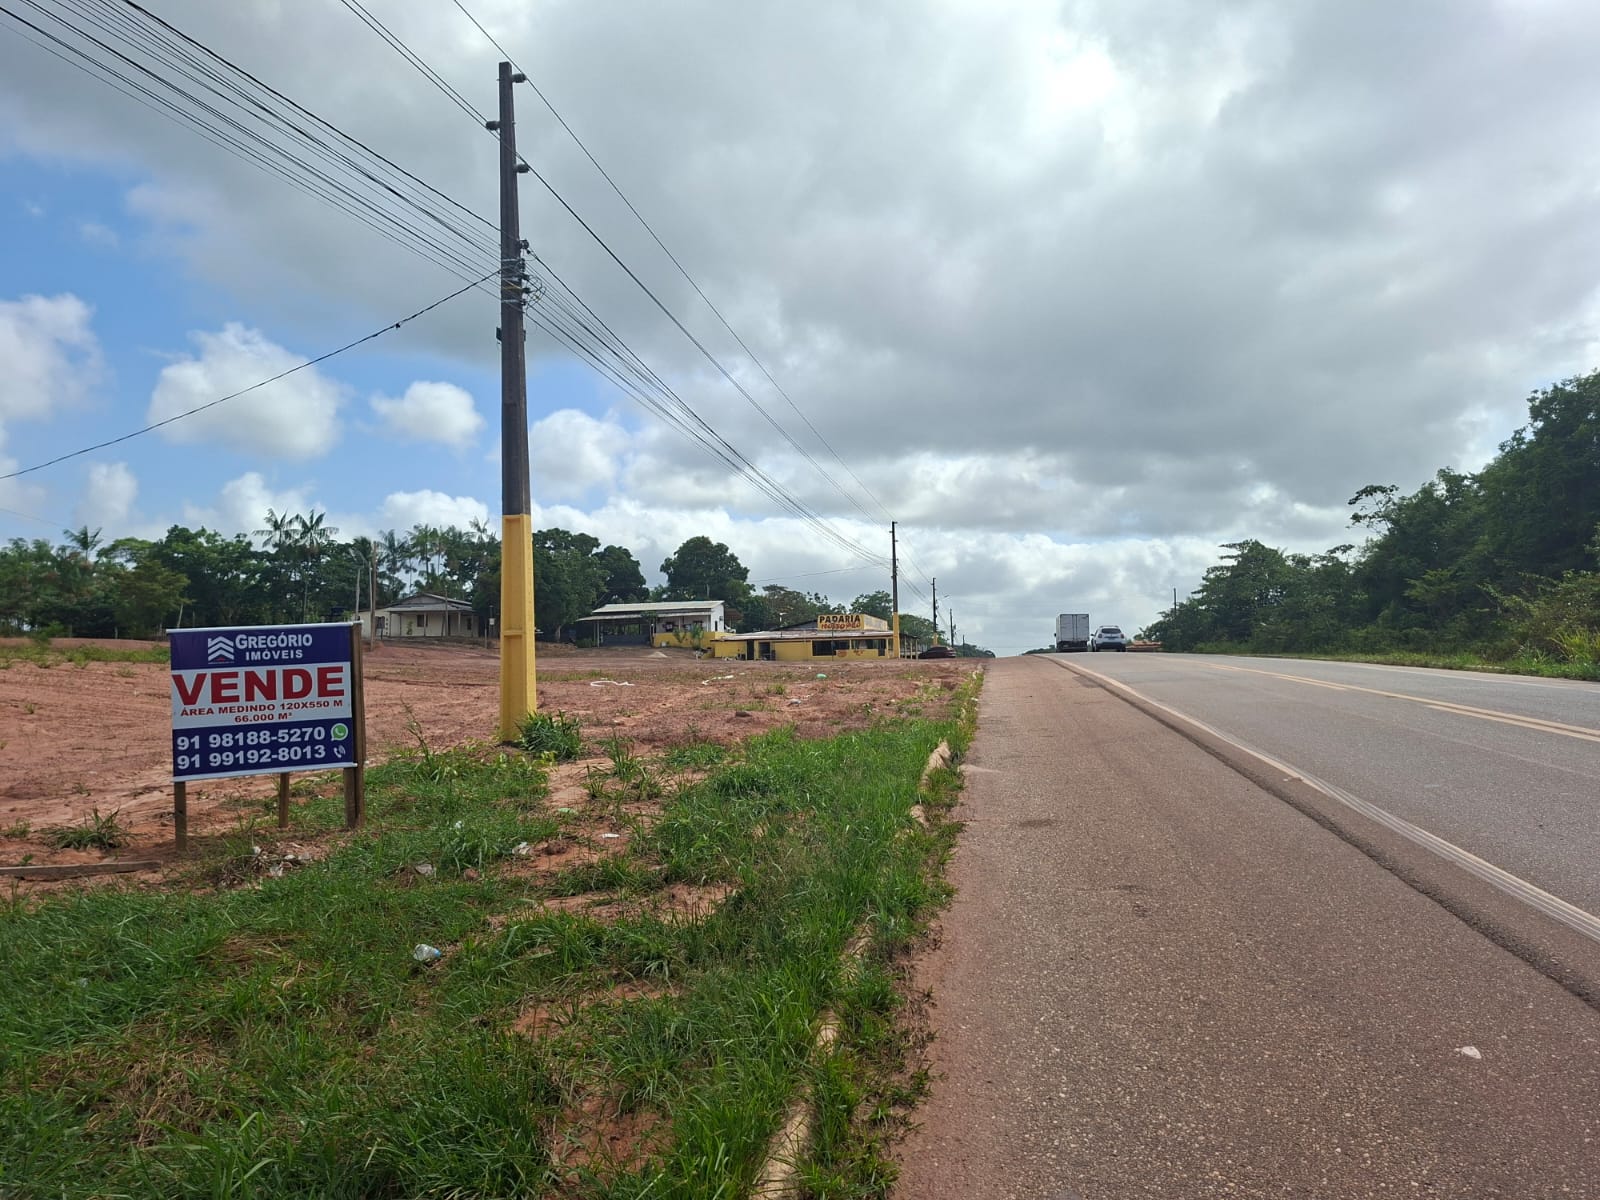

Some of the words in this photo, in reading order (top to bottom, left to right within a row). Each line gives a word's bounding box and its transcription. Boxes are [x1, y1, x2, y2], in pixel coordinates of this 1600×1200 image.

[819, 615, 861, 623] PADARIA
[235, 632, 313, 650] GREGÓRIO
[246, 650, 303, 661] IMÓVEIS
[172, 666, 345, 706] VENDE
[180, 706, 214, 717] ÁREA
[218, 704, 276, 714] MEDINDO
[280, 700, 330, 710] 120X550
[234, 713, 274, 723] 66.000
[177, 735, 200, 750] 91
[209, 726, 325, 748] 98188-5270
[177, 754, 200, 770] 91
[209, 745, 326, 766] 99192-8013
